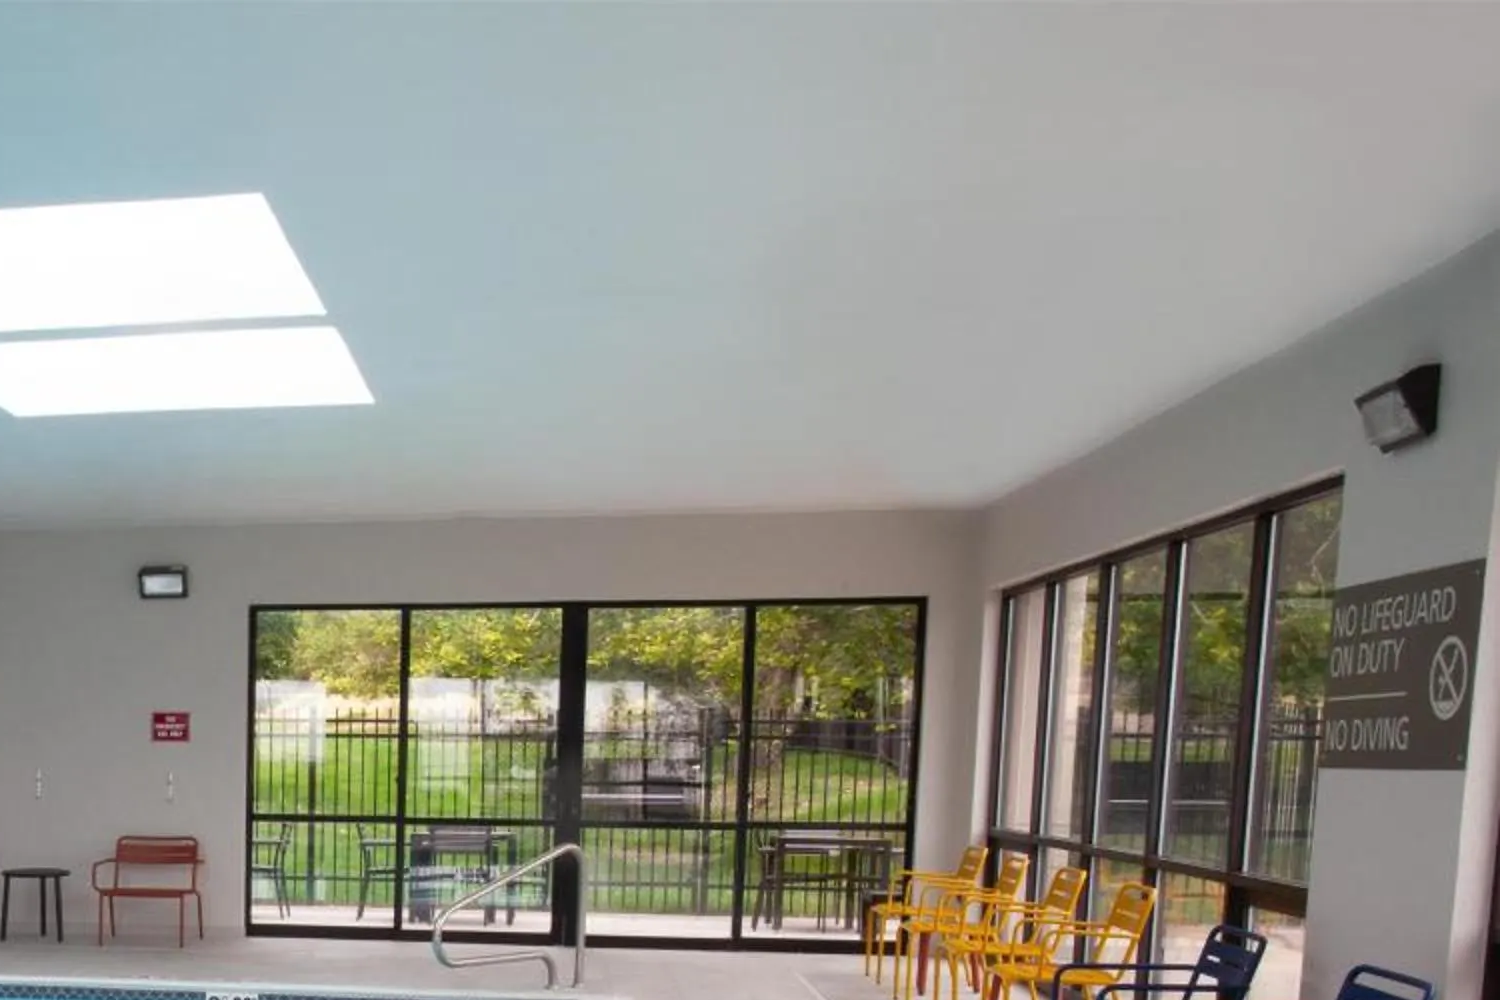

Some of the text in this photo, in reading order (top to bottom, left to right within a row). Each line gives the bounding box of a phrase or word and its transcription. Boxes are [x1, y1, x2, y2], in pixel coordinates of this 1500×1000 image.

[1334, 586, 1456, 637] NO LIFEGUARD
[1330, 638, 1405, 678] ON DUTY
[1325, 716, 1410, 751] NO DIVING
